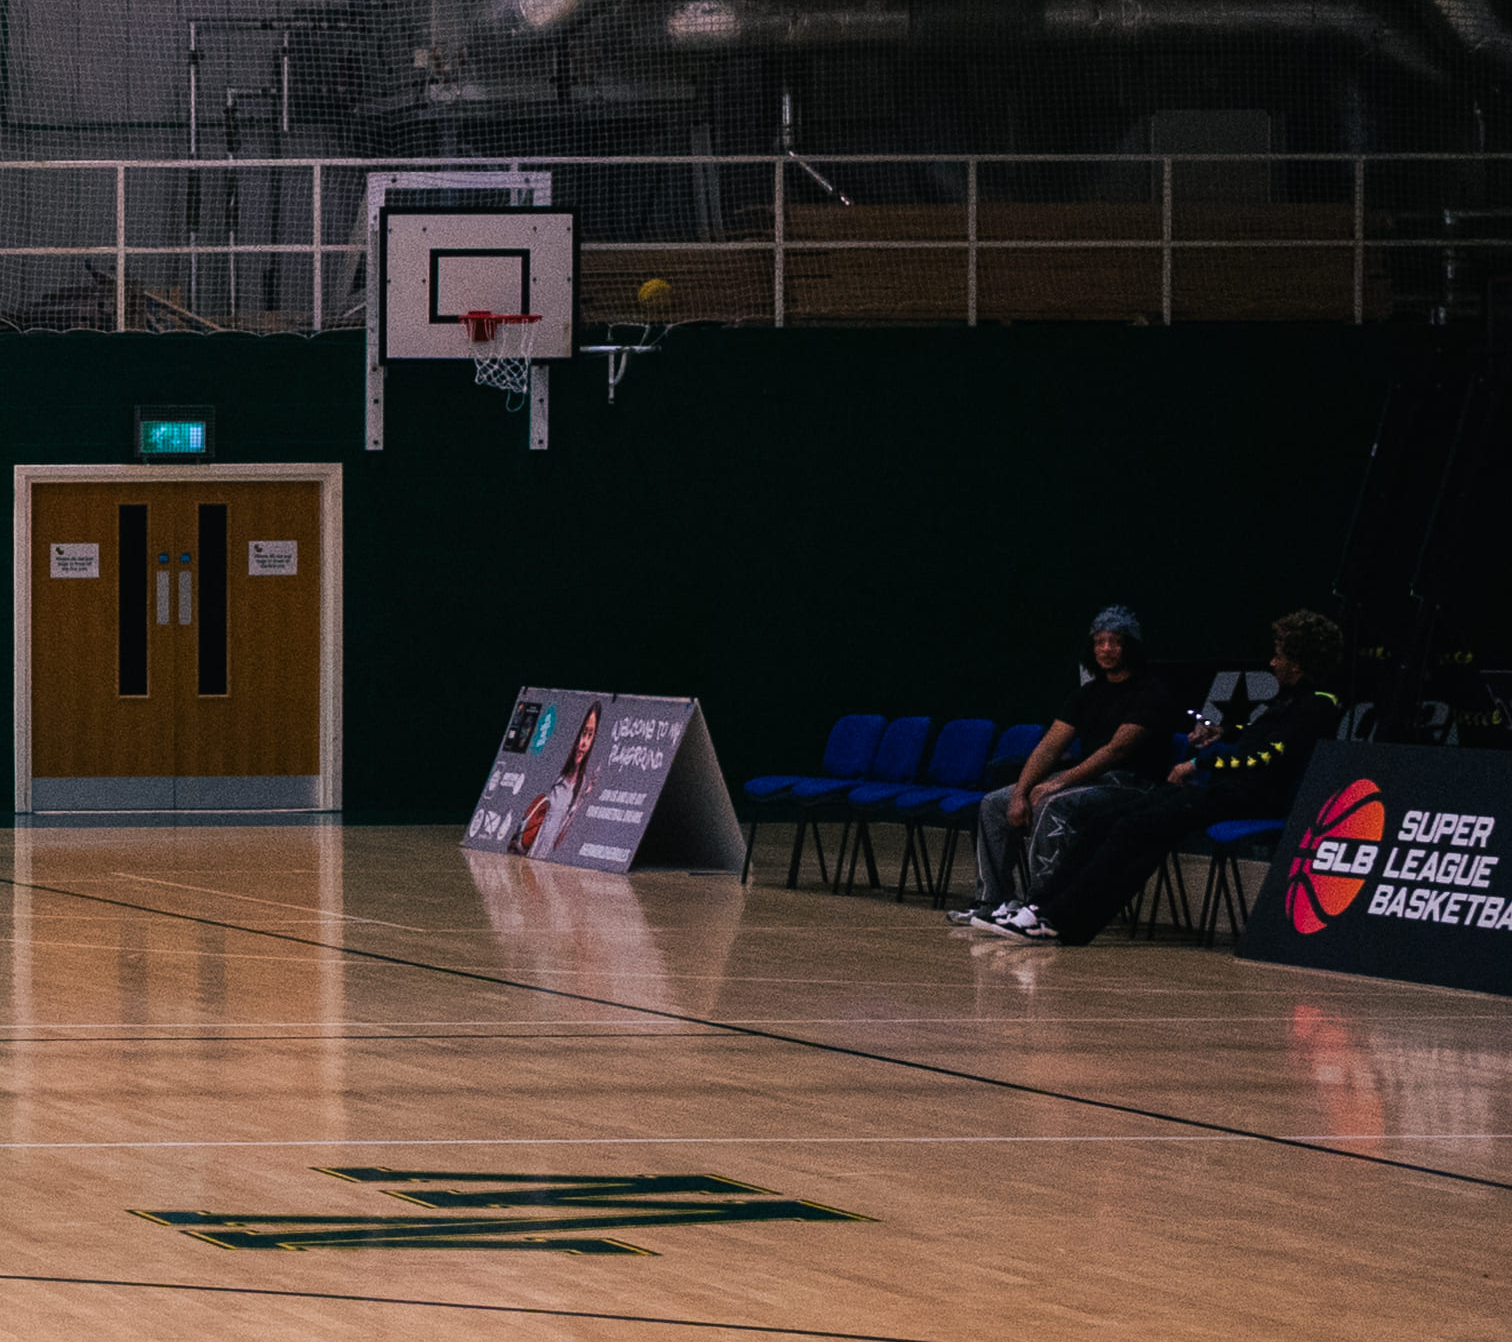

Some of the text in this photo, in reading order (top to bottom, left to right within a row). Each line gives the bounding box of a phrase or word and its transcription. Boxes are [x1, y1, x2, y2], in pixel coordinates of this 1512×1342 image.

[1397, 811, 1495, 847] SUPER
[1312, 841, 1378, 875] SLB
[1382, 847, 1499, 888] LEAGUE
